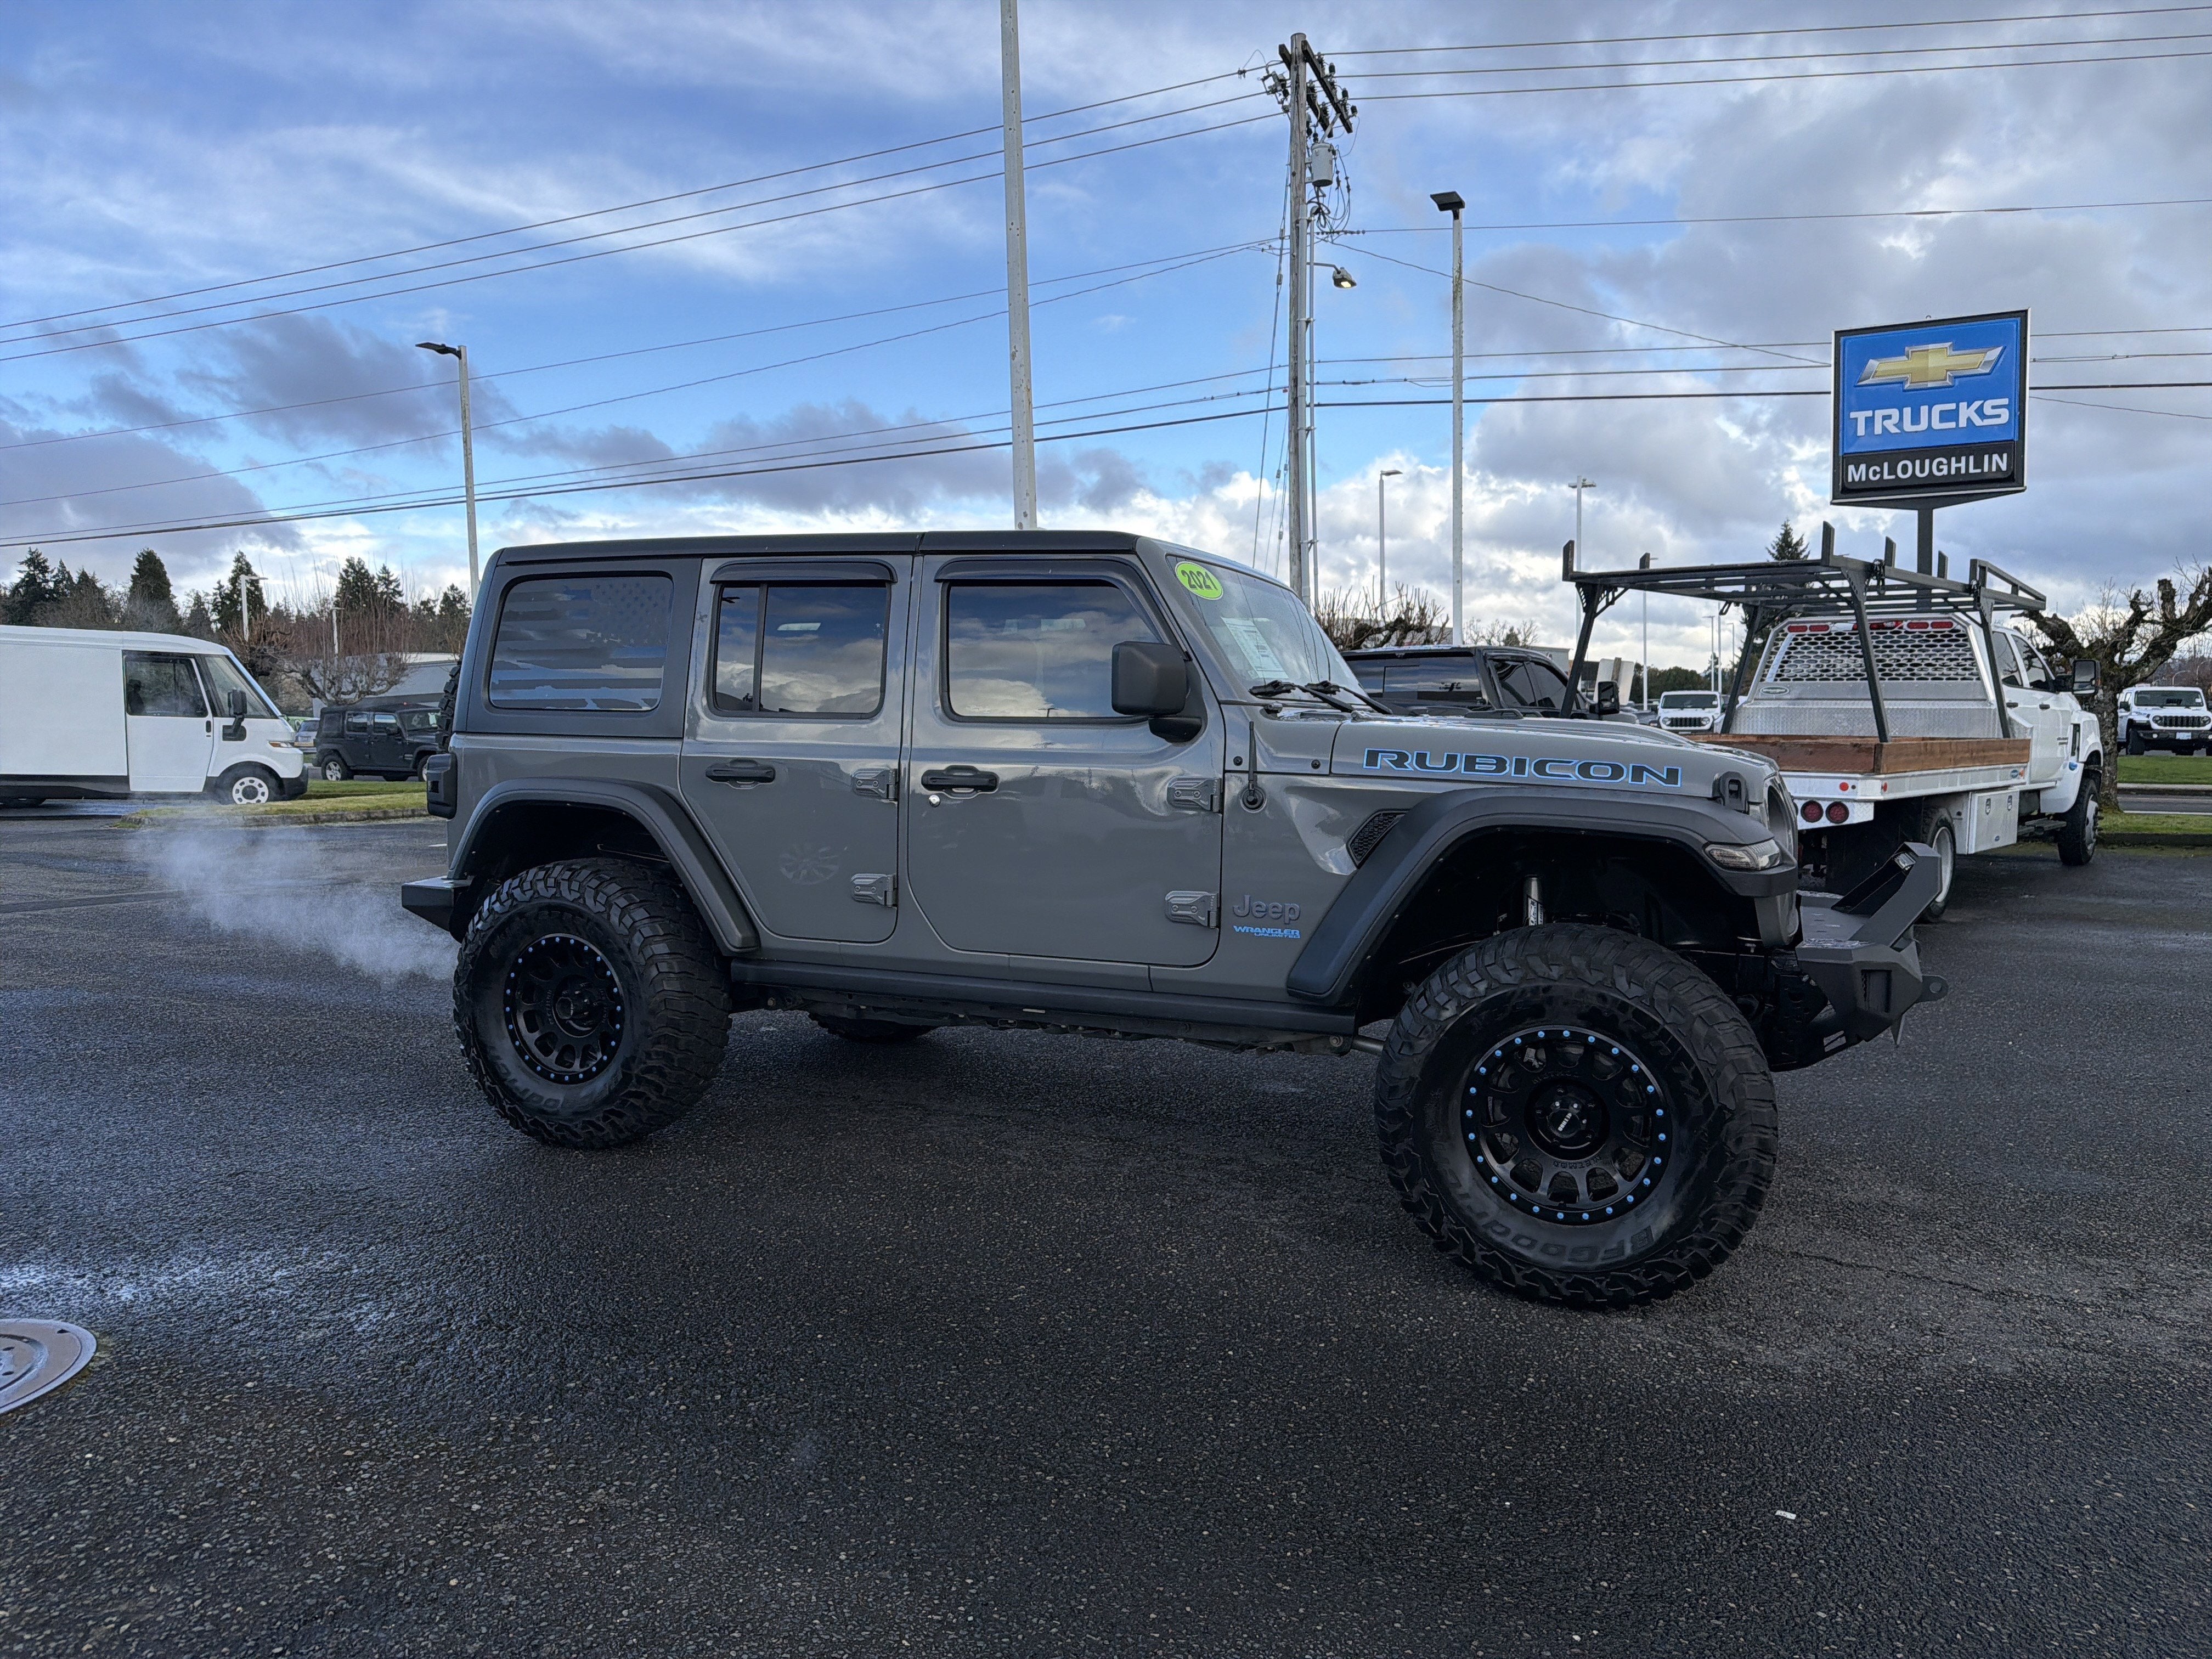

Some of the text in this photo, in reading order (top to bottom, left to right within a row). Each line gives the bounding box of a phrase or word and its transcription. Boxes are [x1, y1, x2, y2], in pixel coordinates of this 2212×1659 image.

[1849, 398, 2010, 437] TRUCKS
[1847, 453, 2008, 483] McLOUGHLIN
[1181, 569, 1218, 591] 2021
[1363, 748, 1683, 787] RUBICON
[1233, 894, 1301, 925] Jeep
[1233, 926, 1300, 935] WRANGLER
